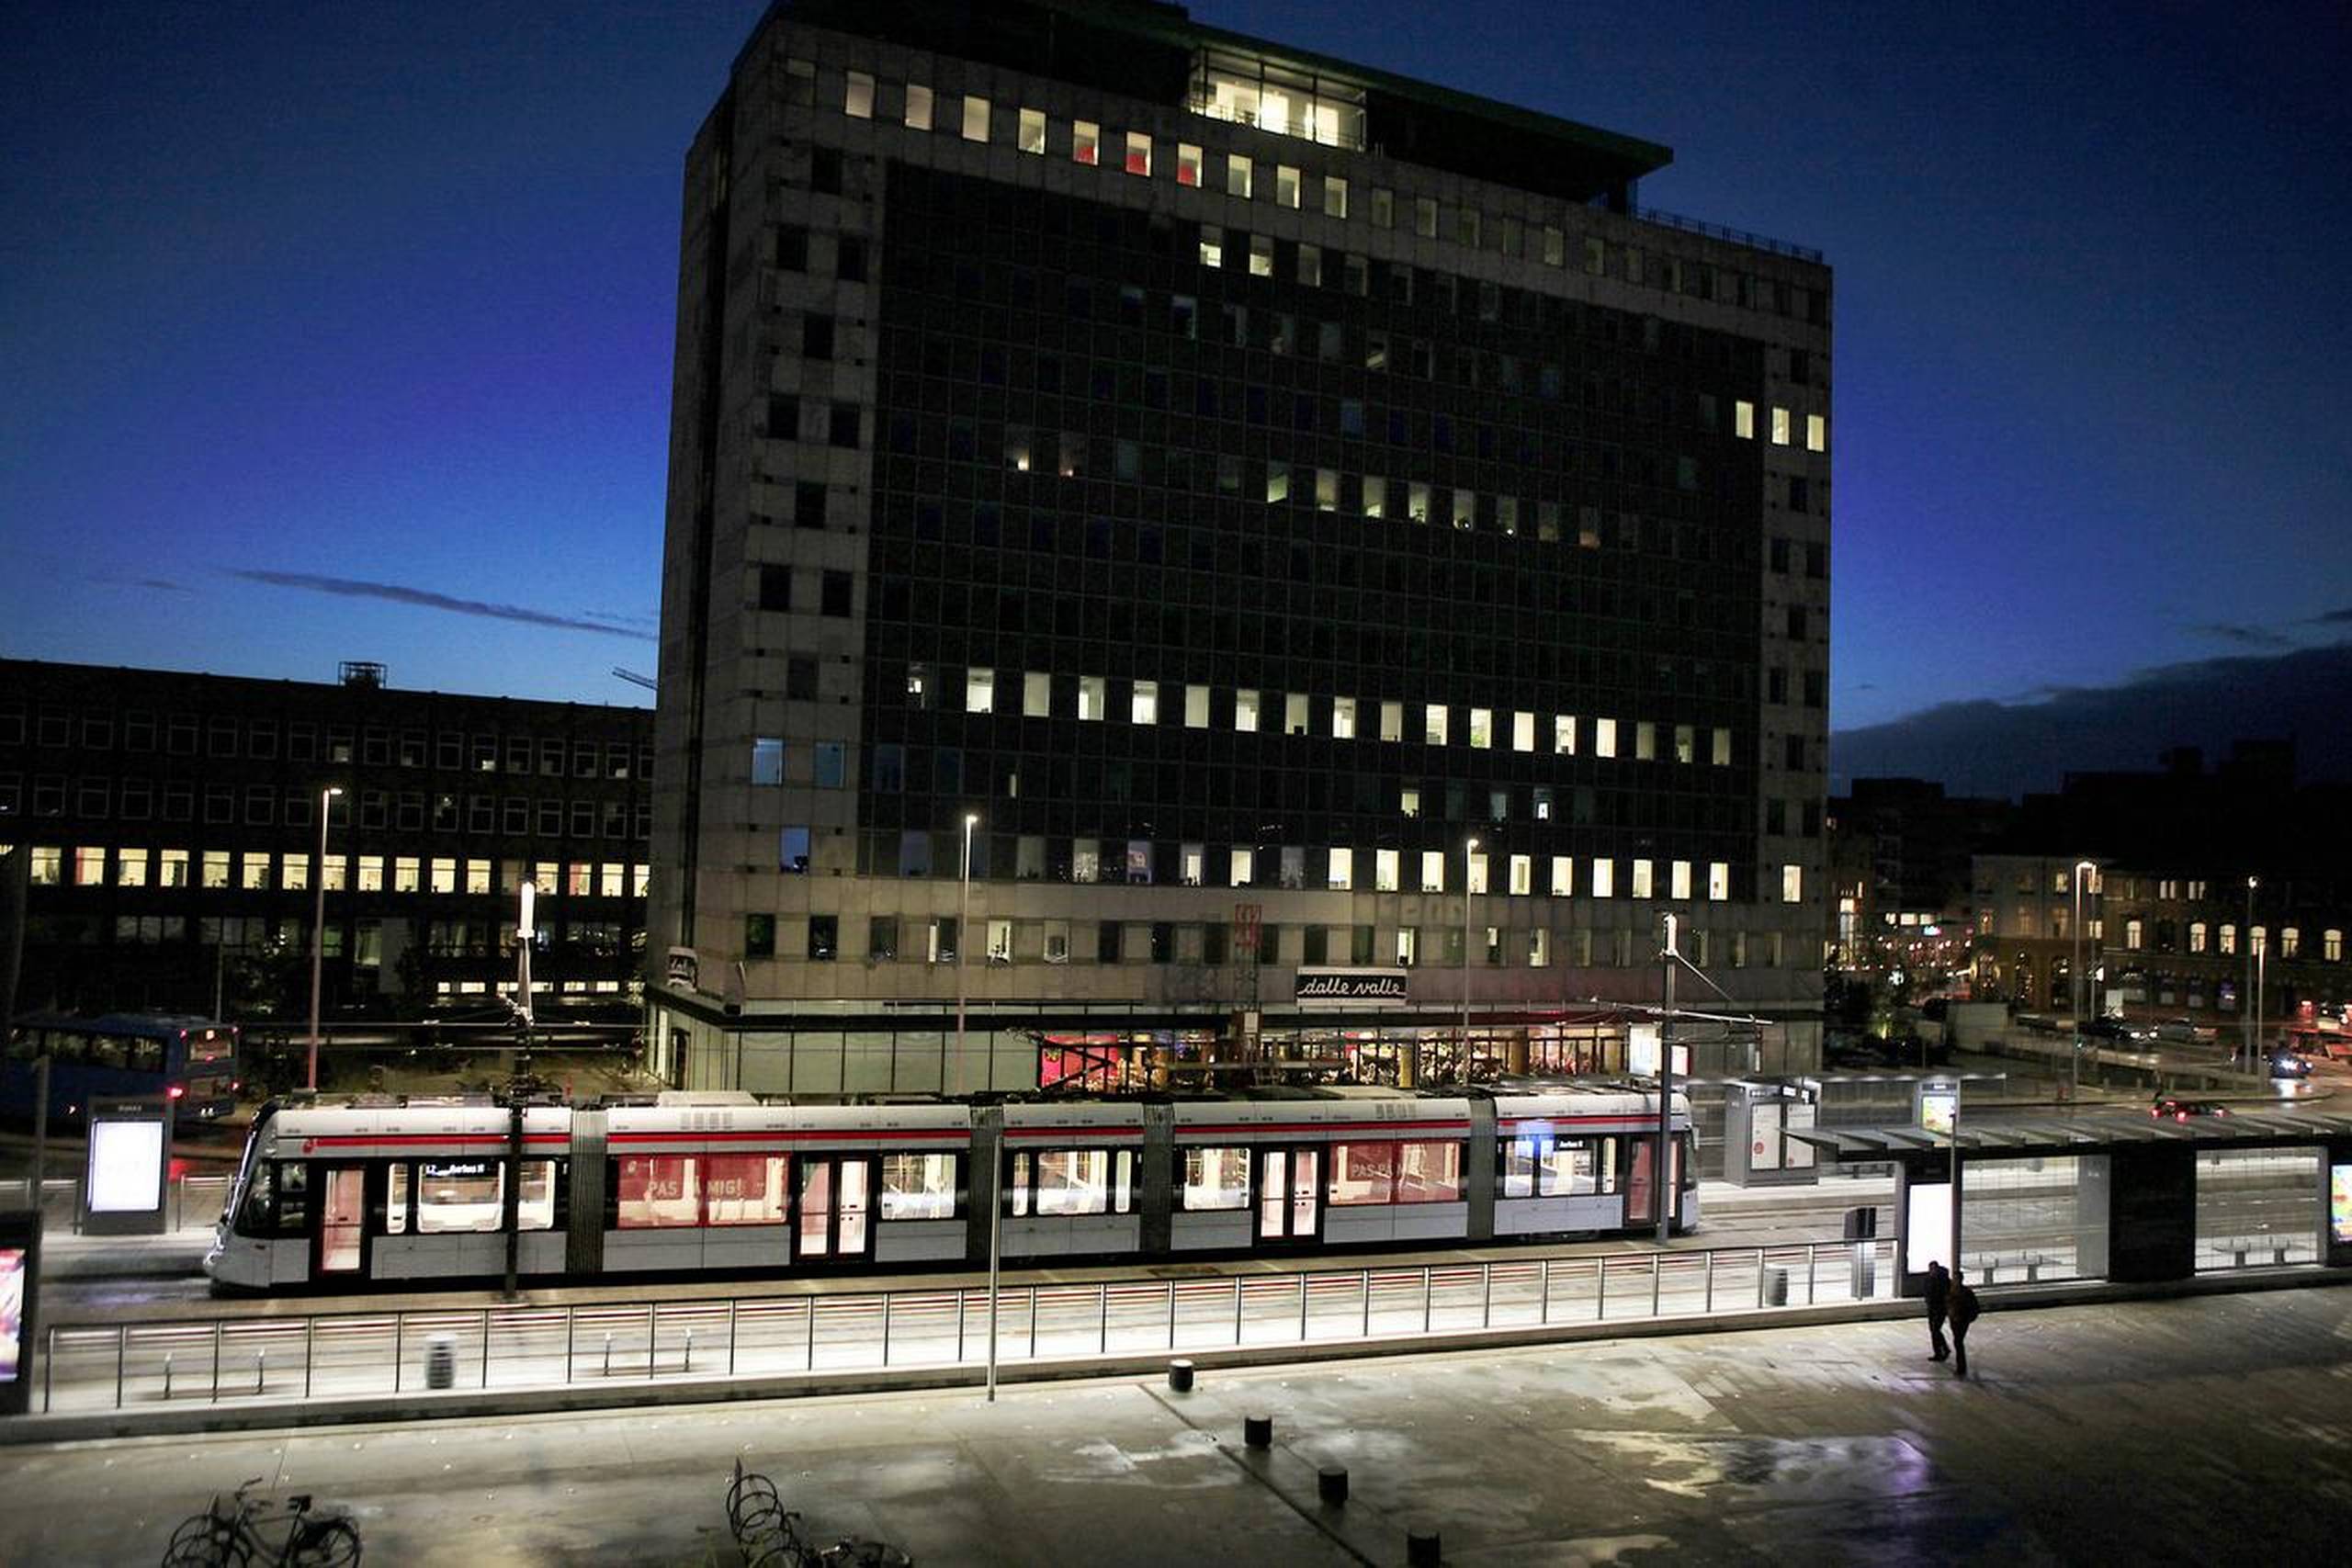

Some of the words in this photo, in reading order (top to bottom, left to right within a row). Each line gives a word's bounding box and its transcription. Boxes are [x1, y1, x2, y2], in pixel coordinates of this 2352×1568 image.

[1297, 977, 1350, 995] dalle
[1351, 978, 1407, 996] valle
[648, 1180, 677, 1195] PAS
